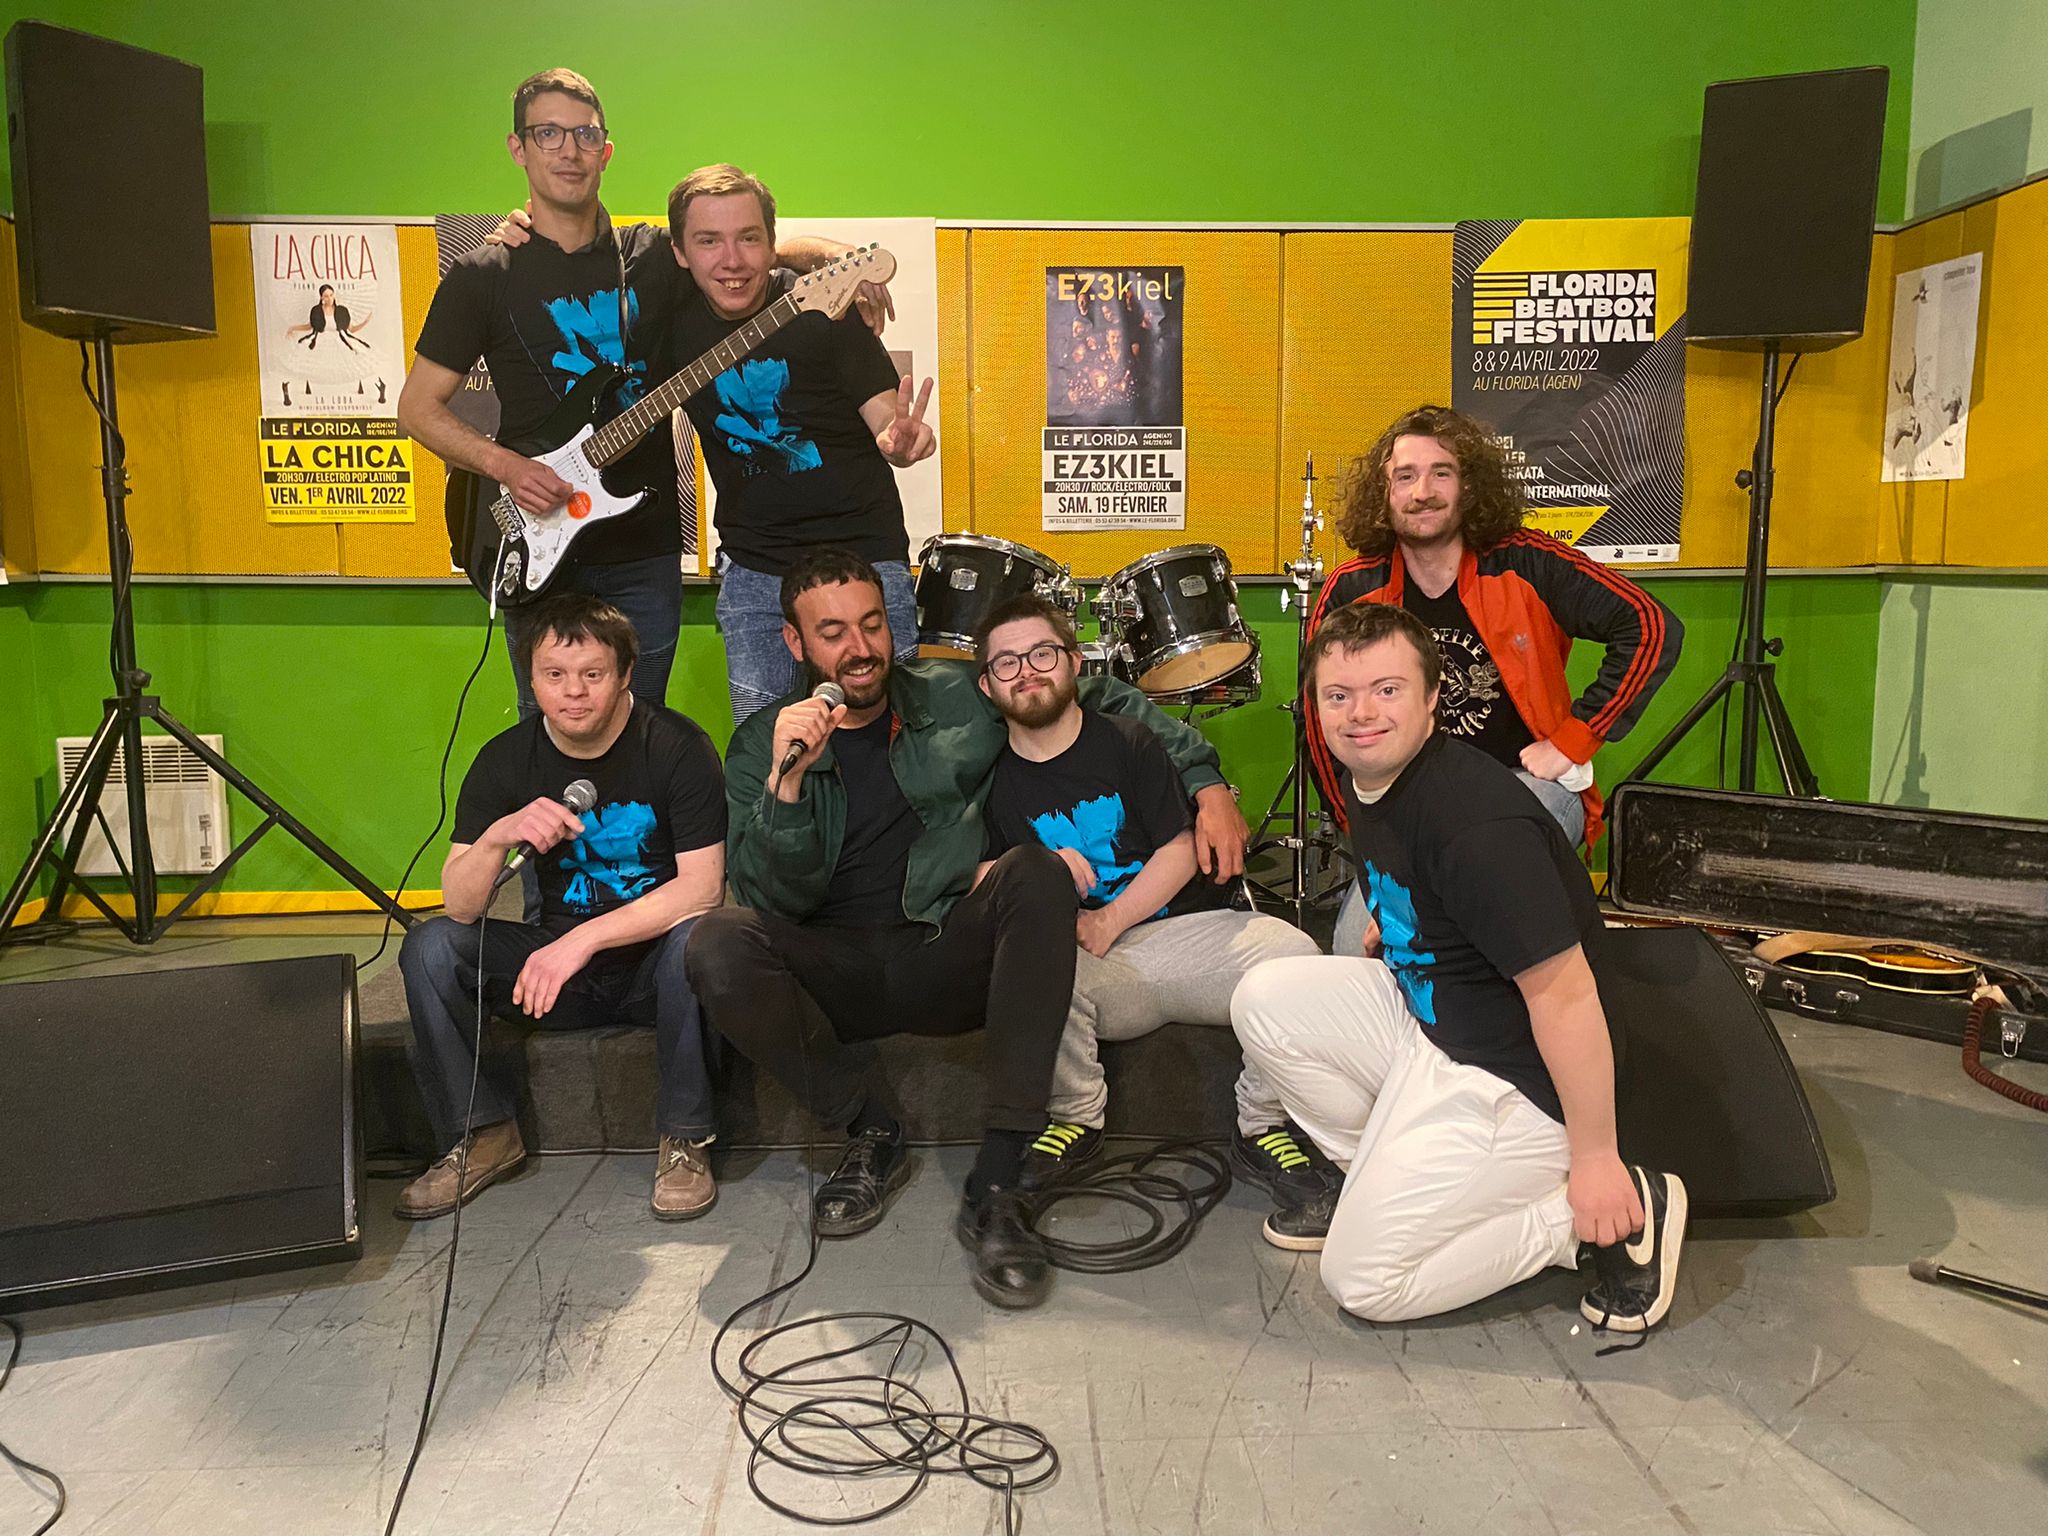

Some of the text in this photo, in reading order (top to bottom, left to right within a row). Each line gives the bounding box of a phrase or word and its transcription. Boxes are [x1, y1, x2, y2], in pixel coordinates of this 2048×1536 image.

[274, 233, 378, 280] LA CHICA
[1058, 272, 1172, 301] EZ3kiel
[1530, 272, 1655, 297] FLORIDA
[1515, 297, 1654, 319] BEATBOX
[1493, 319, 1654, 344] FESTIVAL
[1472, 349, 1600, 372] 8 & 9 AVRIL 2022
[464, 376, 484, 391] AU
[1472, 375, 1582, 391] AU FLORIDA (AGEN)
[272, 422, 362, 436] LE FLORIDA
[1054, 434, 1138, 446] LE FLORIDA
[267, 445, 406, 468] LA CHICA
[1053, 454, 1174, 479] EZ3KIEL
[276, 472, 304, 483] 20H30
[316, 472, 350, 483] ELECTRO
[352, 472, 368, 482] POP
[369, 472, 398, 483] LATINO
[1055, 482, 1080, 492] 20H30
[270, 487, 302, 505] VEN.
[326, 487, 368, 505] AVRIL
[371, 487, 406, 504] 2022
[1524, 484, 1610, 499] INTERNATIONAL
[1058, 492, 1168, 514] SAM. 19 FÉVRIER
